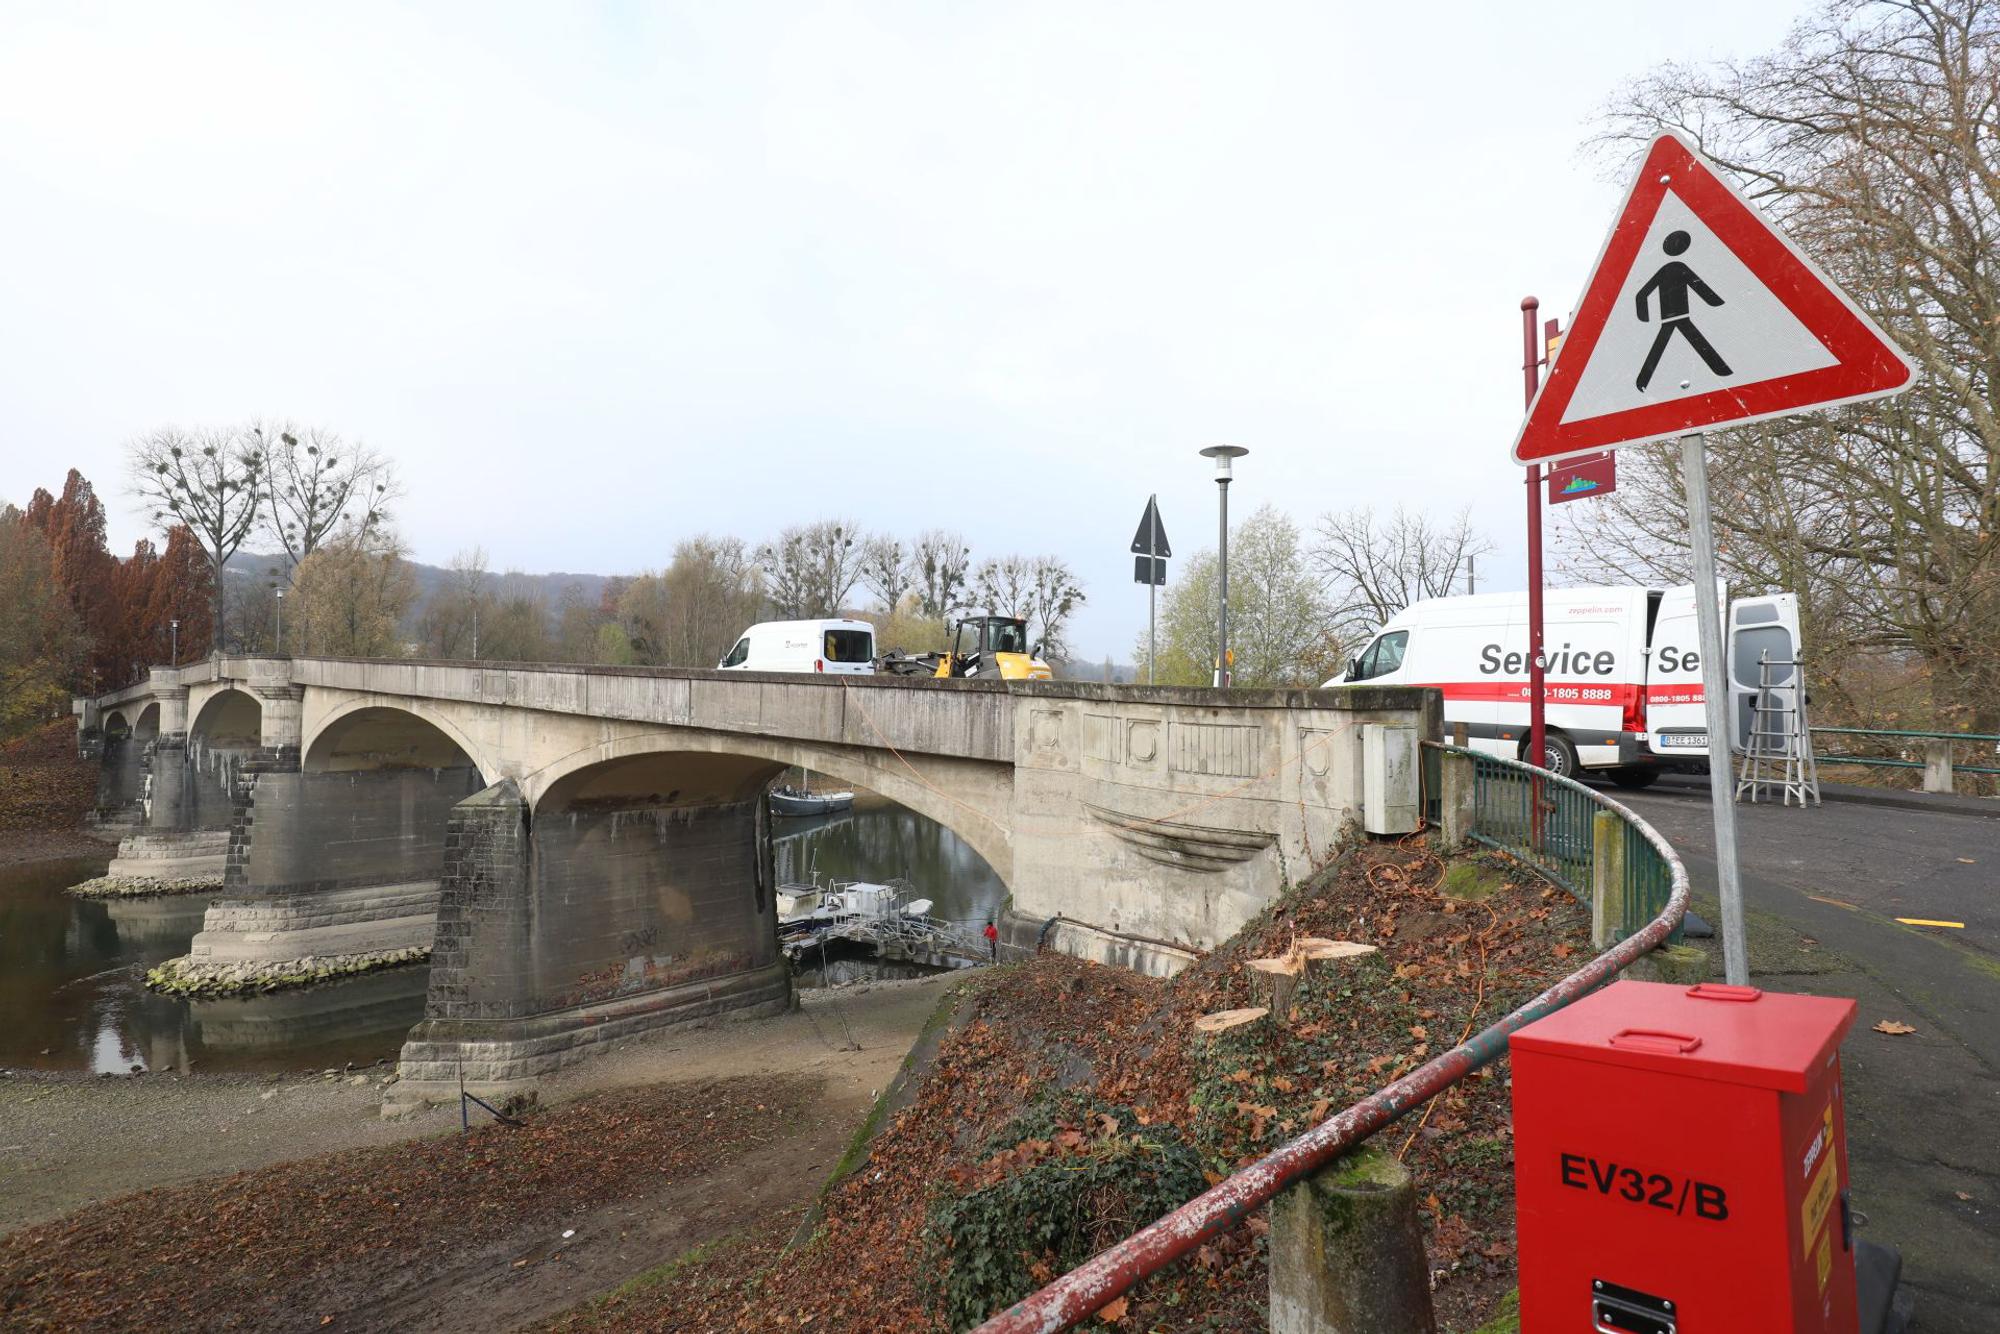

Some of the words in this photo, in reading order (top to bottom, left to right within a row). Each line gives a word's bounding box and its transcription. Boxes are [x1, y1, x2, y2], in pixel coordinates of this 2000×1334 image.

[1568, 605, 1623, 615] zeppelin.com
[1658, 646, 1700, 673] Se
[1582, 688, 1612, 700] 8888
[1560, 1152, 1729, 1222] EV32/B
